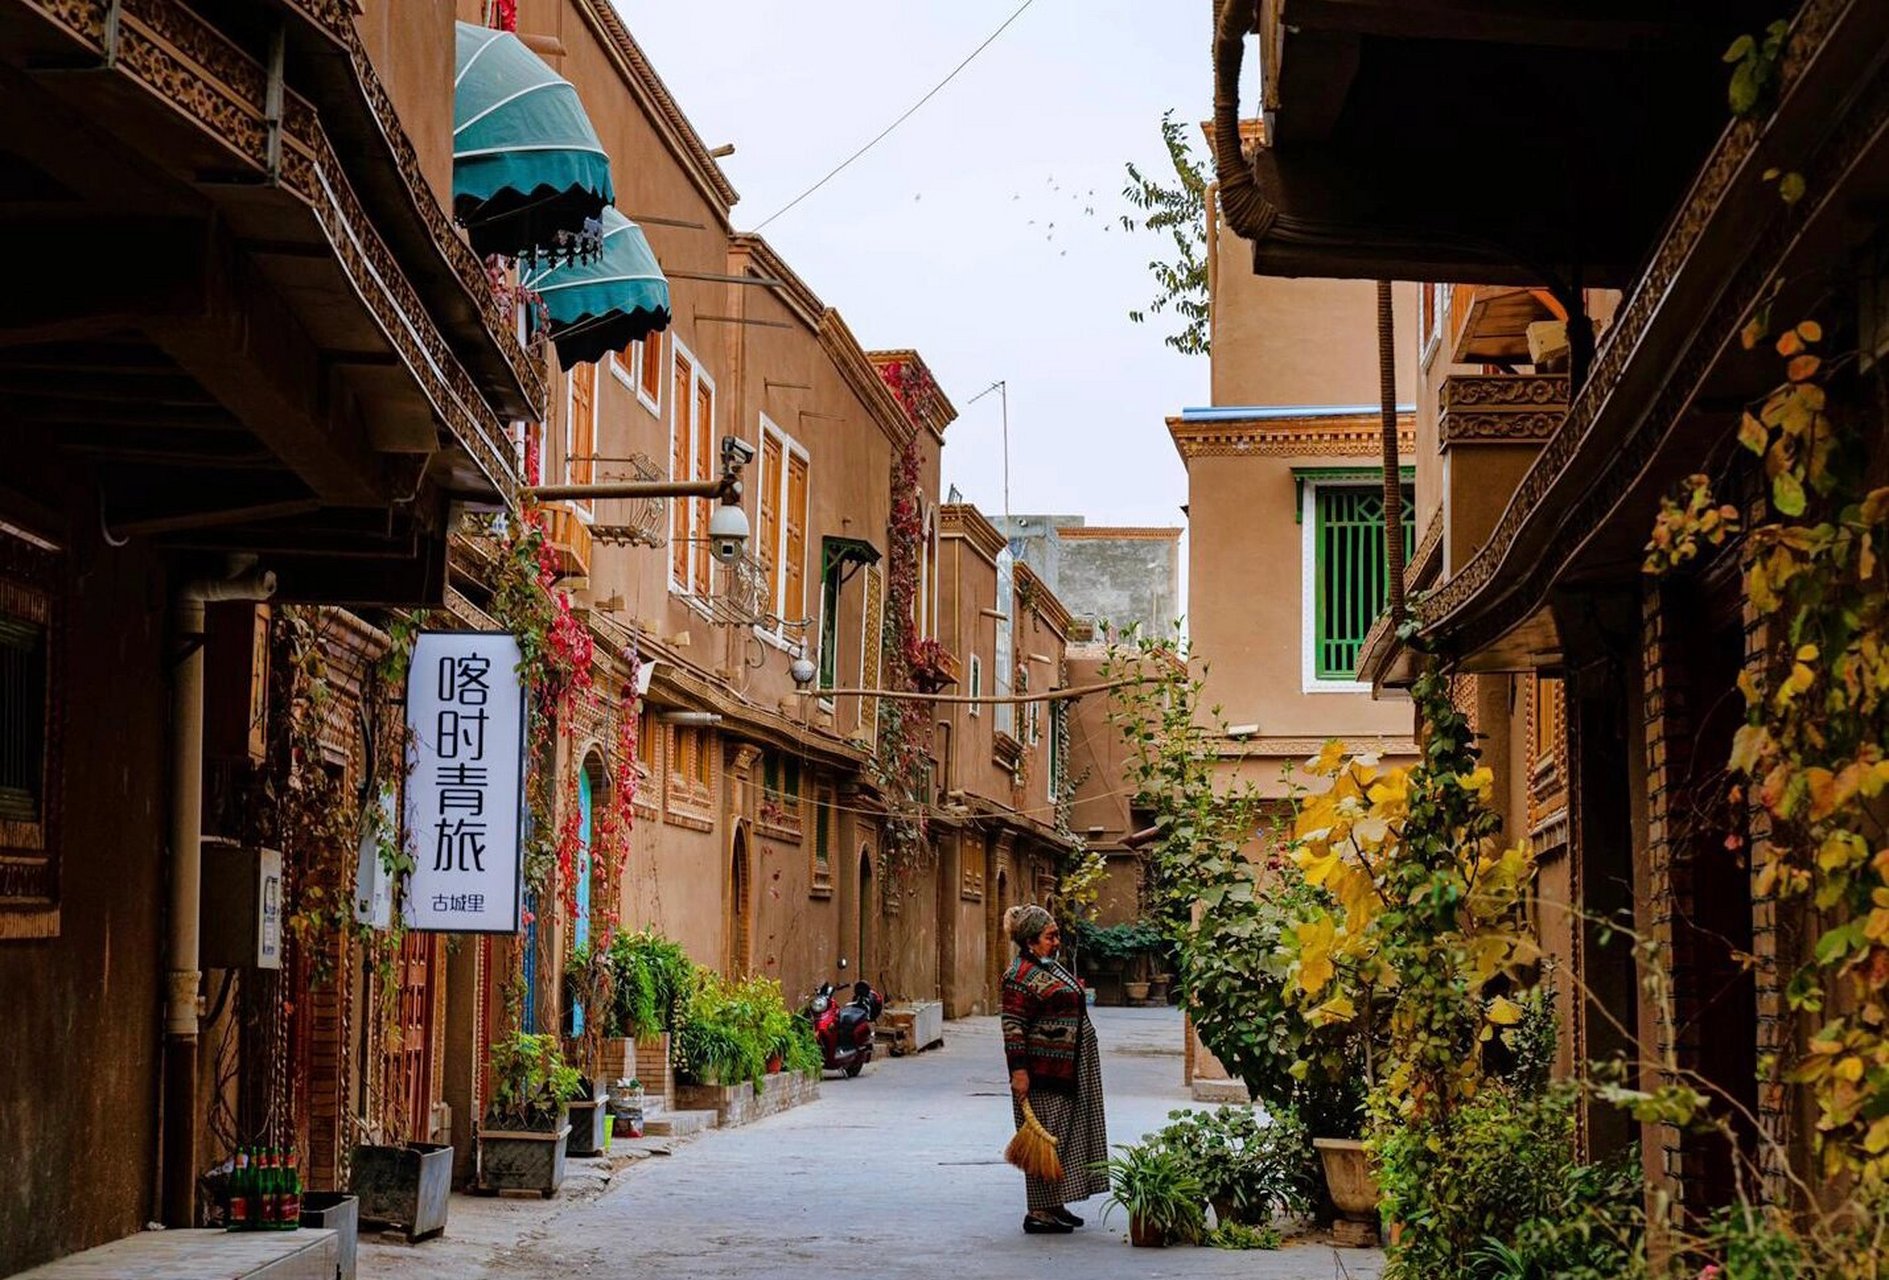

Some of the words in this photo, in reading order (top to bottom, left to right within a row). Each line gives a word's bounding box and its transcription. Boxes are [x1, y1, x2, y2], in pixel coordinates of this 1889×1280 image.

[433, 652, 491, 872] 喀时青旅
[432, 893, 485, 913] 古城里
